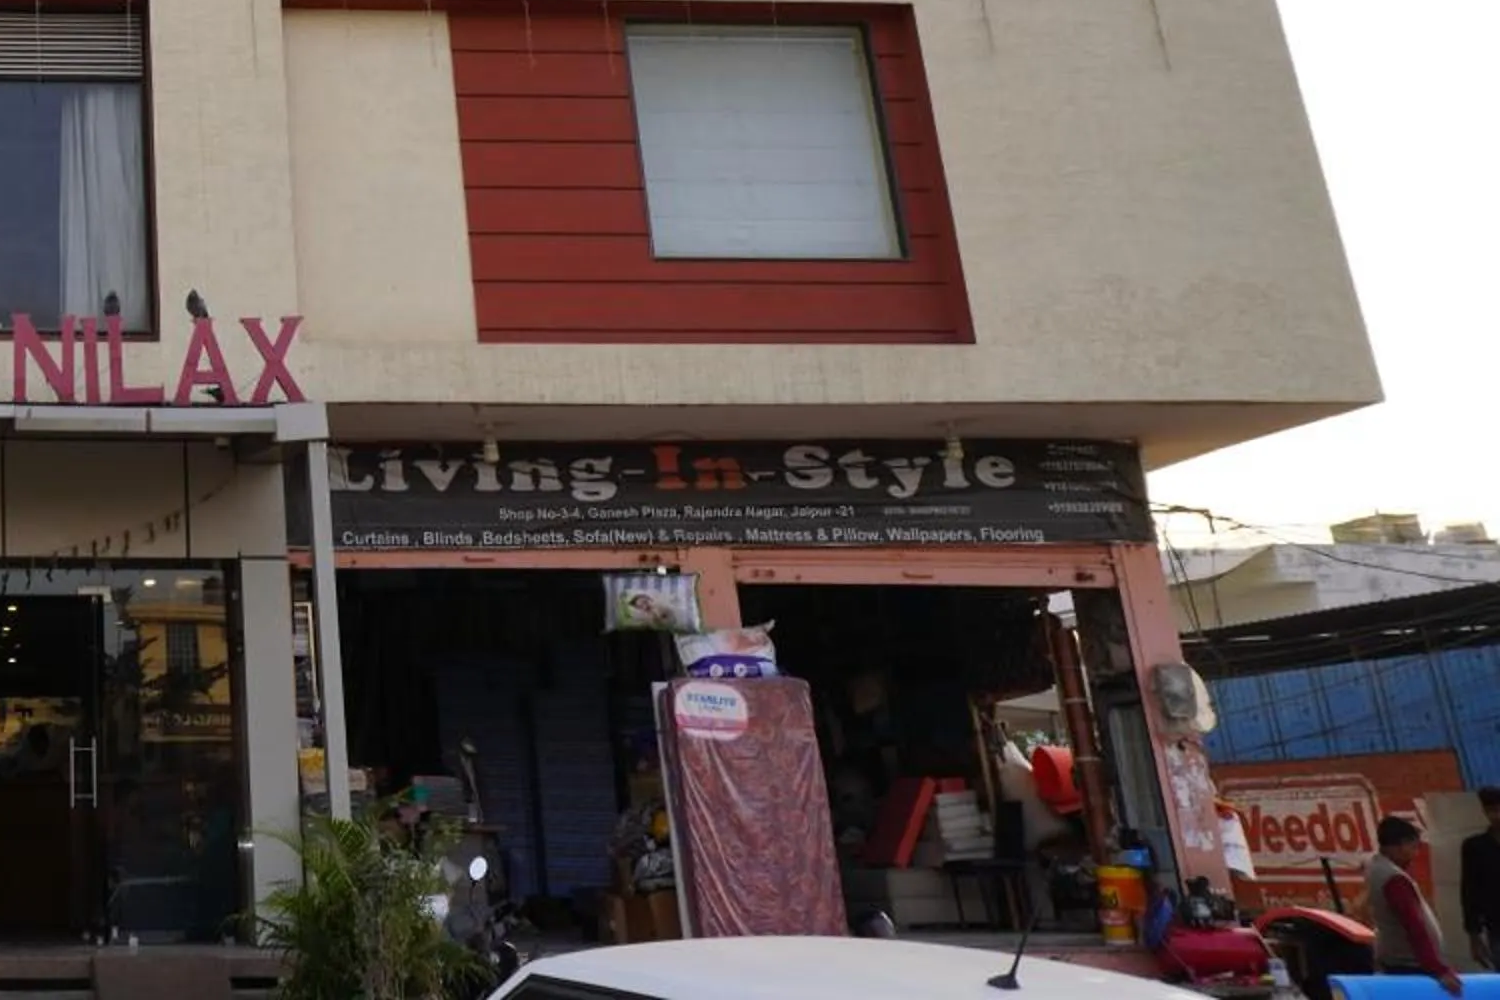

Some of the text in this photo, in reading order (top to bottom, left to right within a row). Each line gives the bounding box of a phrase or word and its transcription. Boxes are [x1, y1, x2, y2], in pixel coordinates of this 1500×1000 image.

[12, 311, 308, 406] NILAX
[499, 507, 534, 521] Shop
[587, 507, 639, 519] Ganesh
[746, 528, 813, 542] Mattress
[817, 528, 829, 541] &
[979, 527, 1045, 543] Flooring
